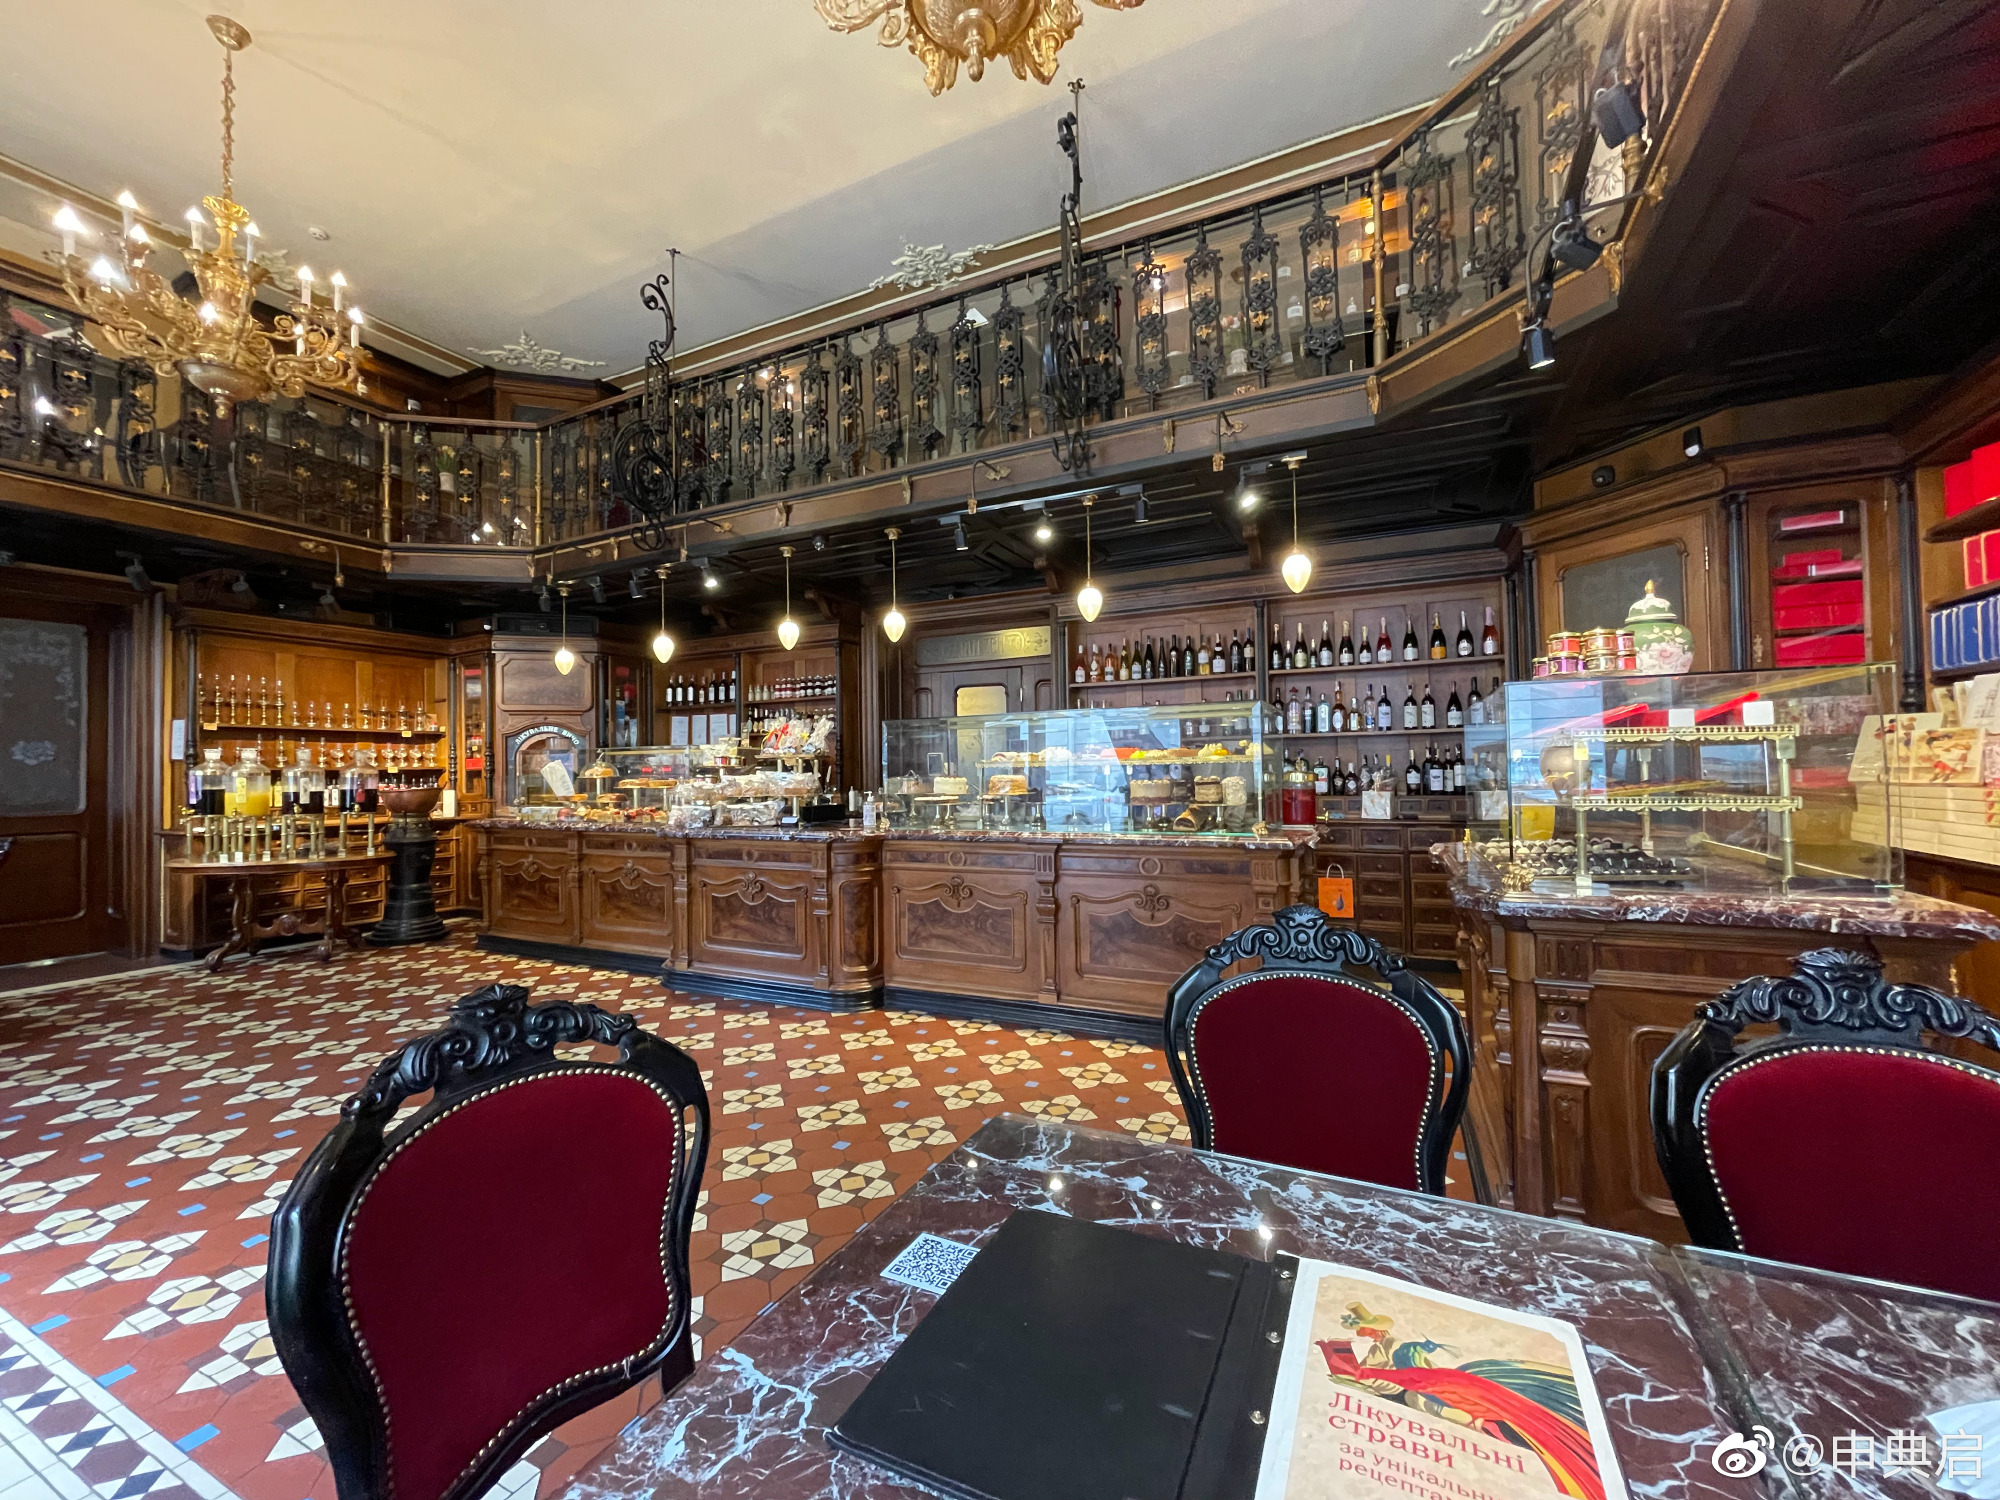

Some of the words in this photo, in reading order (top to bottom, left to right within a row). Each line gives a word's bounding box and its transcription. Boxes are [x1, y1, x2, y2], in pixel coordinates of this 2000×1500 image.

[1328, 1391, 1526, 1474] Лікувальні
[1328, 1414, 1455, 1469] страви
[1339, 1442, 1366, 1459] за
[1372, 1451, 1502, 1500] унікальн
[1339, 1457, 1452, 1500] рецепта
